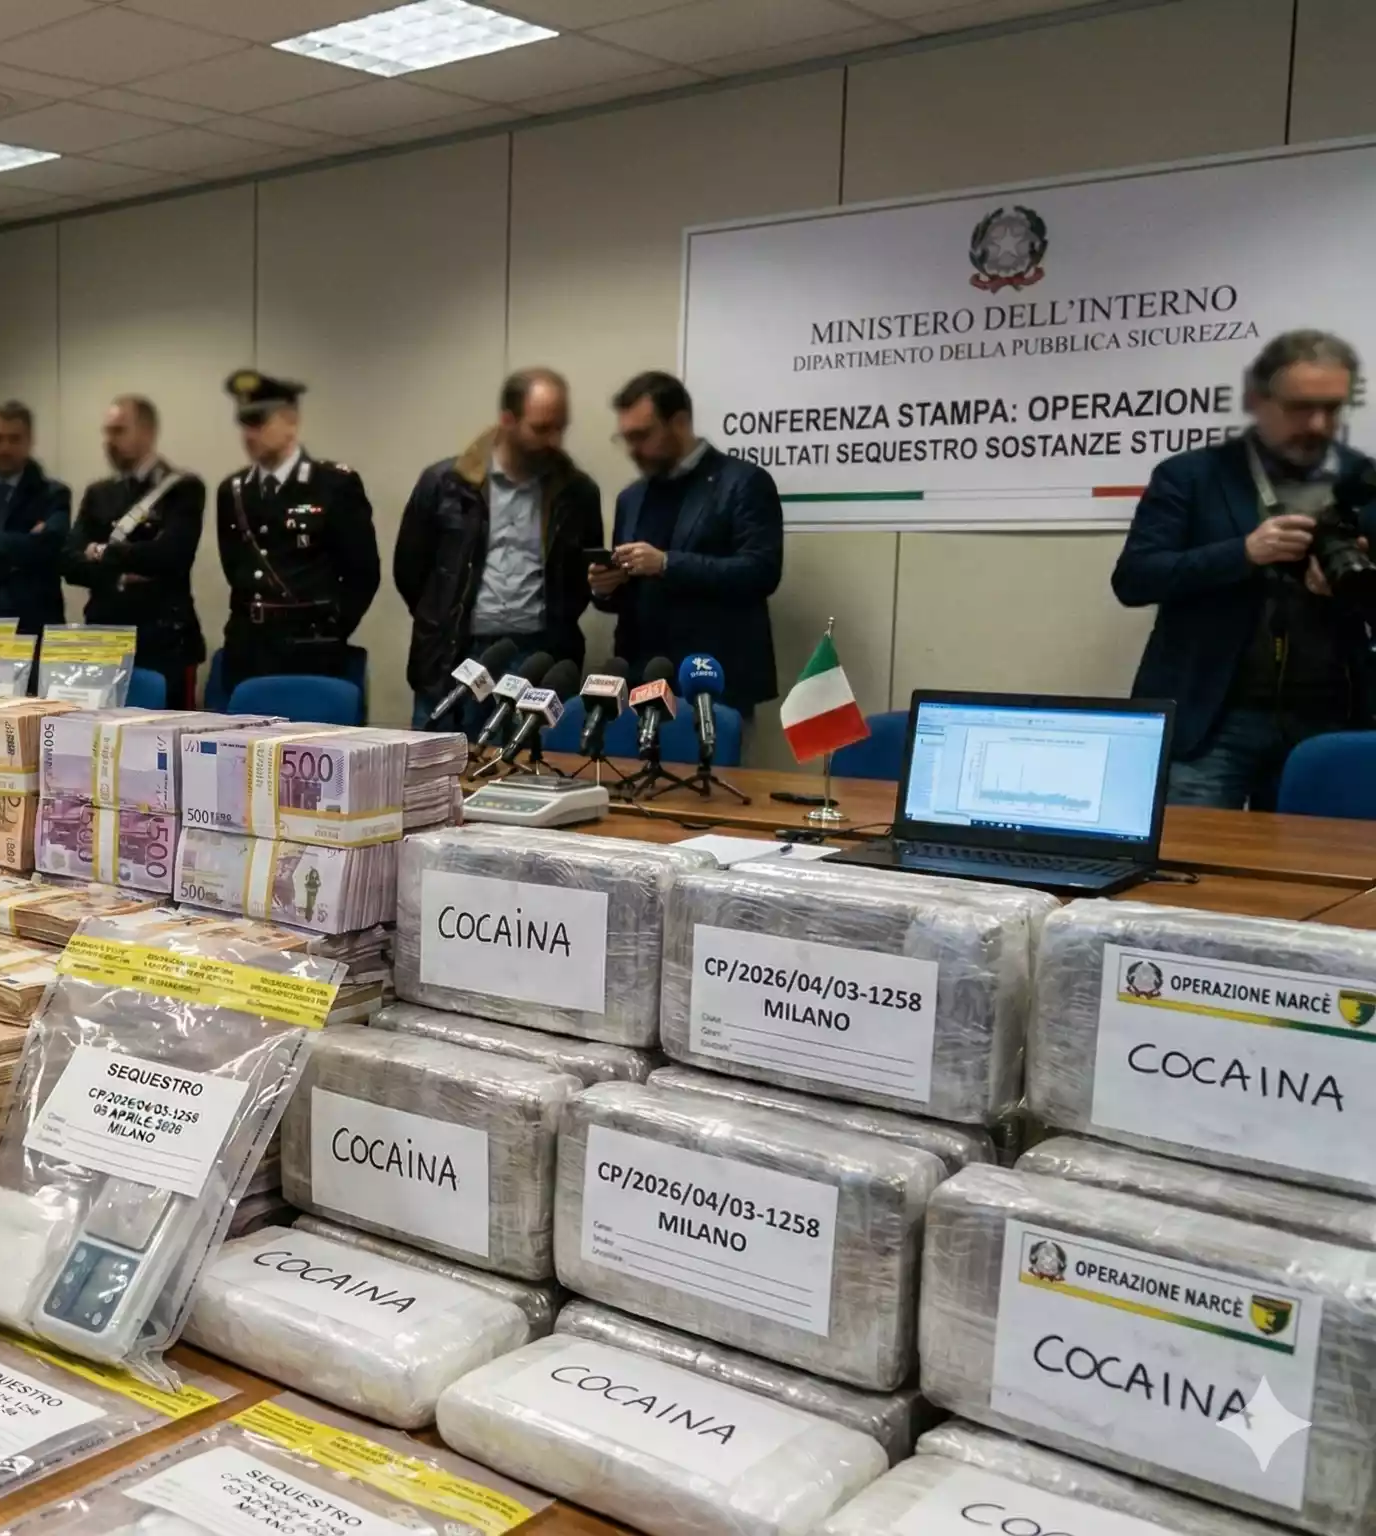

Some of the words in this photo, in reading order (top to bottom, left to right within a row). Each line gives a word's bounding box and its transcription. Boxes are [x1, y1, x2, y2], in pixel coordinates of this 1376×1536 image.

[809, 307, 974, 346] MINISTERO
[984, 284, 1238, 331] DELL'INTERNO
[792, 346, 934, 372] DIPARTIMENTO
[939, 340, 1006, 361] DELLA
[1012, 332, 1122, 357] PUBBLICA
[1127, 320, 1260, 348] SICUREZZA
[723, 404, 890, 436] CONFERENZA
[898, 397, 1017, 428] STAMPA:
[1028, 385, 1233, 422] OPERAZIONE
[836, 437, 977, 465] SEQUESTRO
[985, 431, 1121, 459] SOSTANZE
[280, 750, 334, 783] 500
[187, 807, 209, 825] 500
[704, 957, 922, 1012] CP/2026/04/03-1258
[1170, 975, 1271, 1005] OPERAZIONE
[1275, 991, 1332, 1015] NARCÈ
[763, 998, 851, 1031] MILANO
[107, 1063, 204, 1097] SEQUESTRO
[1127, 1043, 1344, 1112] COCAINA
[107, 1120, 156, 1143] MILANO
[597, 1161, 820, 1238] CP/2026/04/03-1258
[658, 1211, 747, 1252] MILANO
[253, 1251, 416, 1314] COCAINA
[1075, 1260, 1180, 1301] OPERAZIONE
[1184, 1287, 1244, 1319] NARCÈ
[551, 1366, 736, 1445] COCAINA
[1033, 1335, 1254, 1430] COCAINA
[245, 1469, 363, 1526] SEQUESTRO
[960, 1503, 1074, 1536] CO
